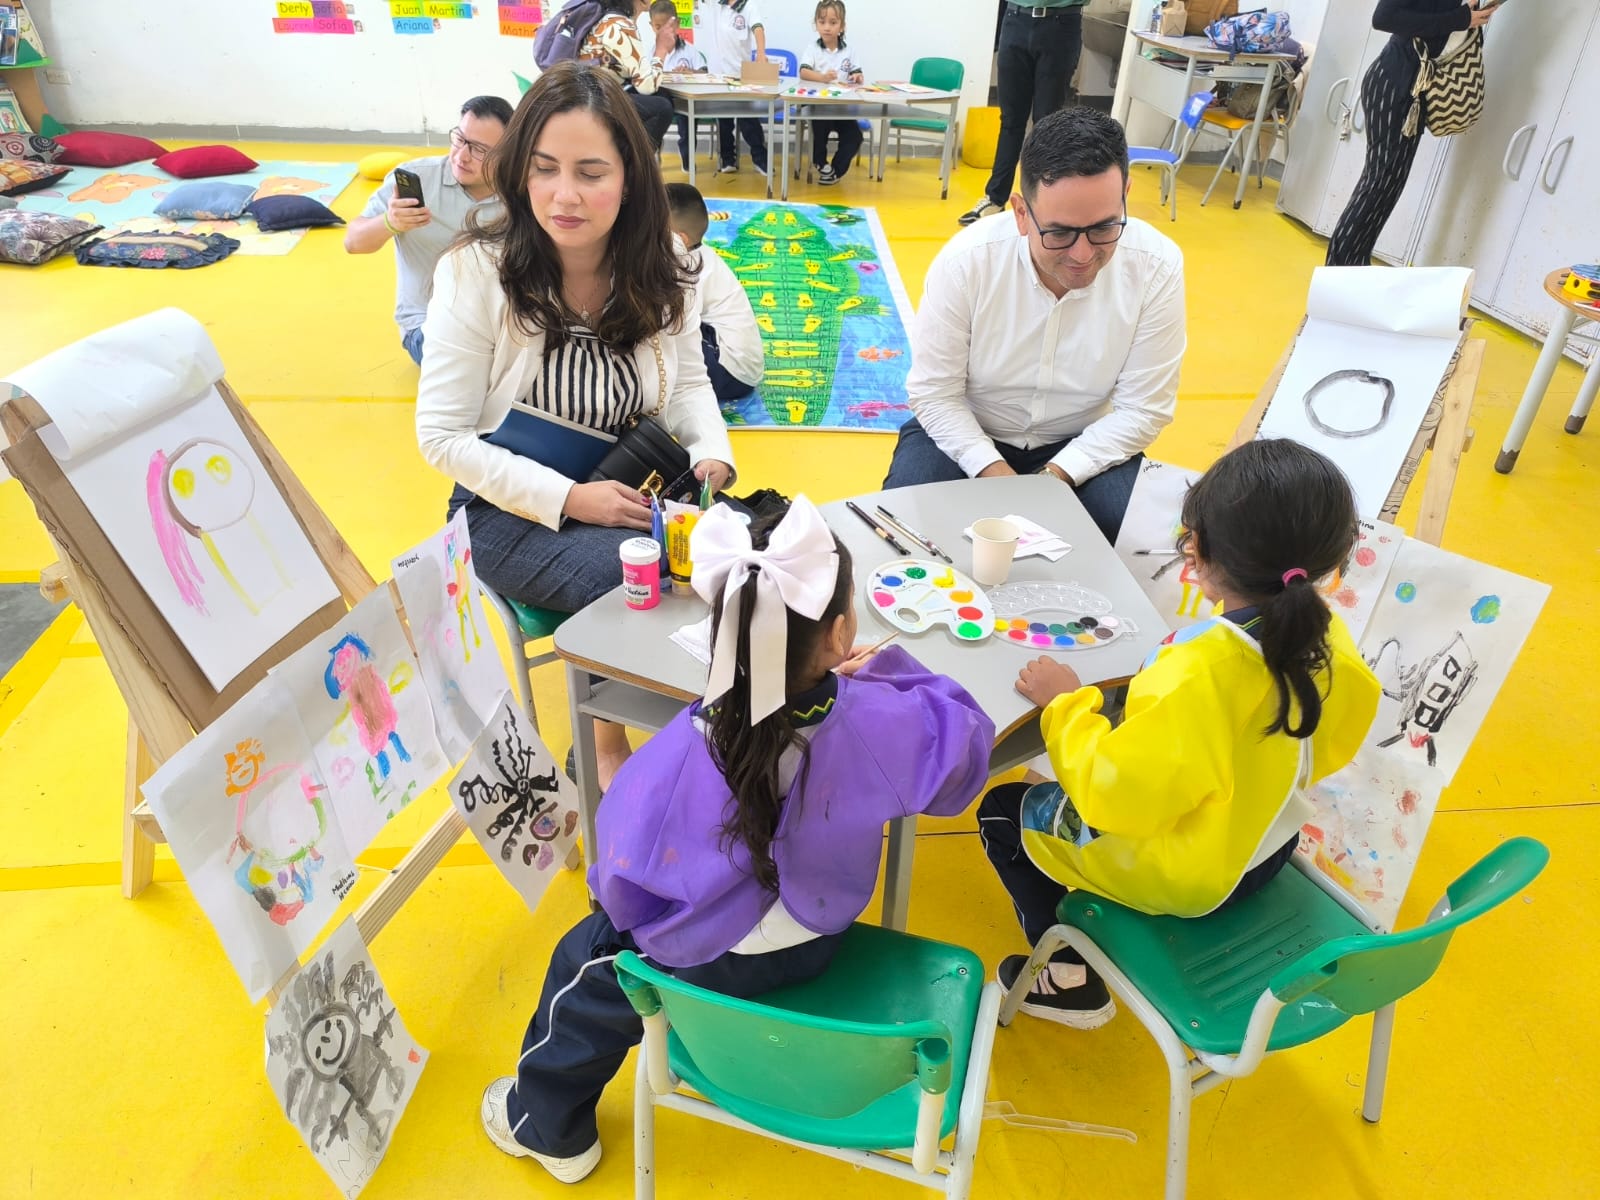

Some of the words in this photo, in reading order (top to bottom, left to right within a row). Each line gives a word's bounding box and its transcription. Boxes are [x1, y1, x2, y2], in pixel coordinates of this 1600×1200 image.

[279, 2, 309, 16] Derly
[394, 4, 421, 15] Juan
[429, 4, 466, 16] Martin
[318, 19, 348, 31] Sofia
[396, 19, 431, 31] Ariana
